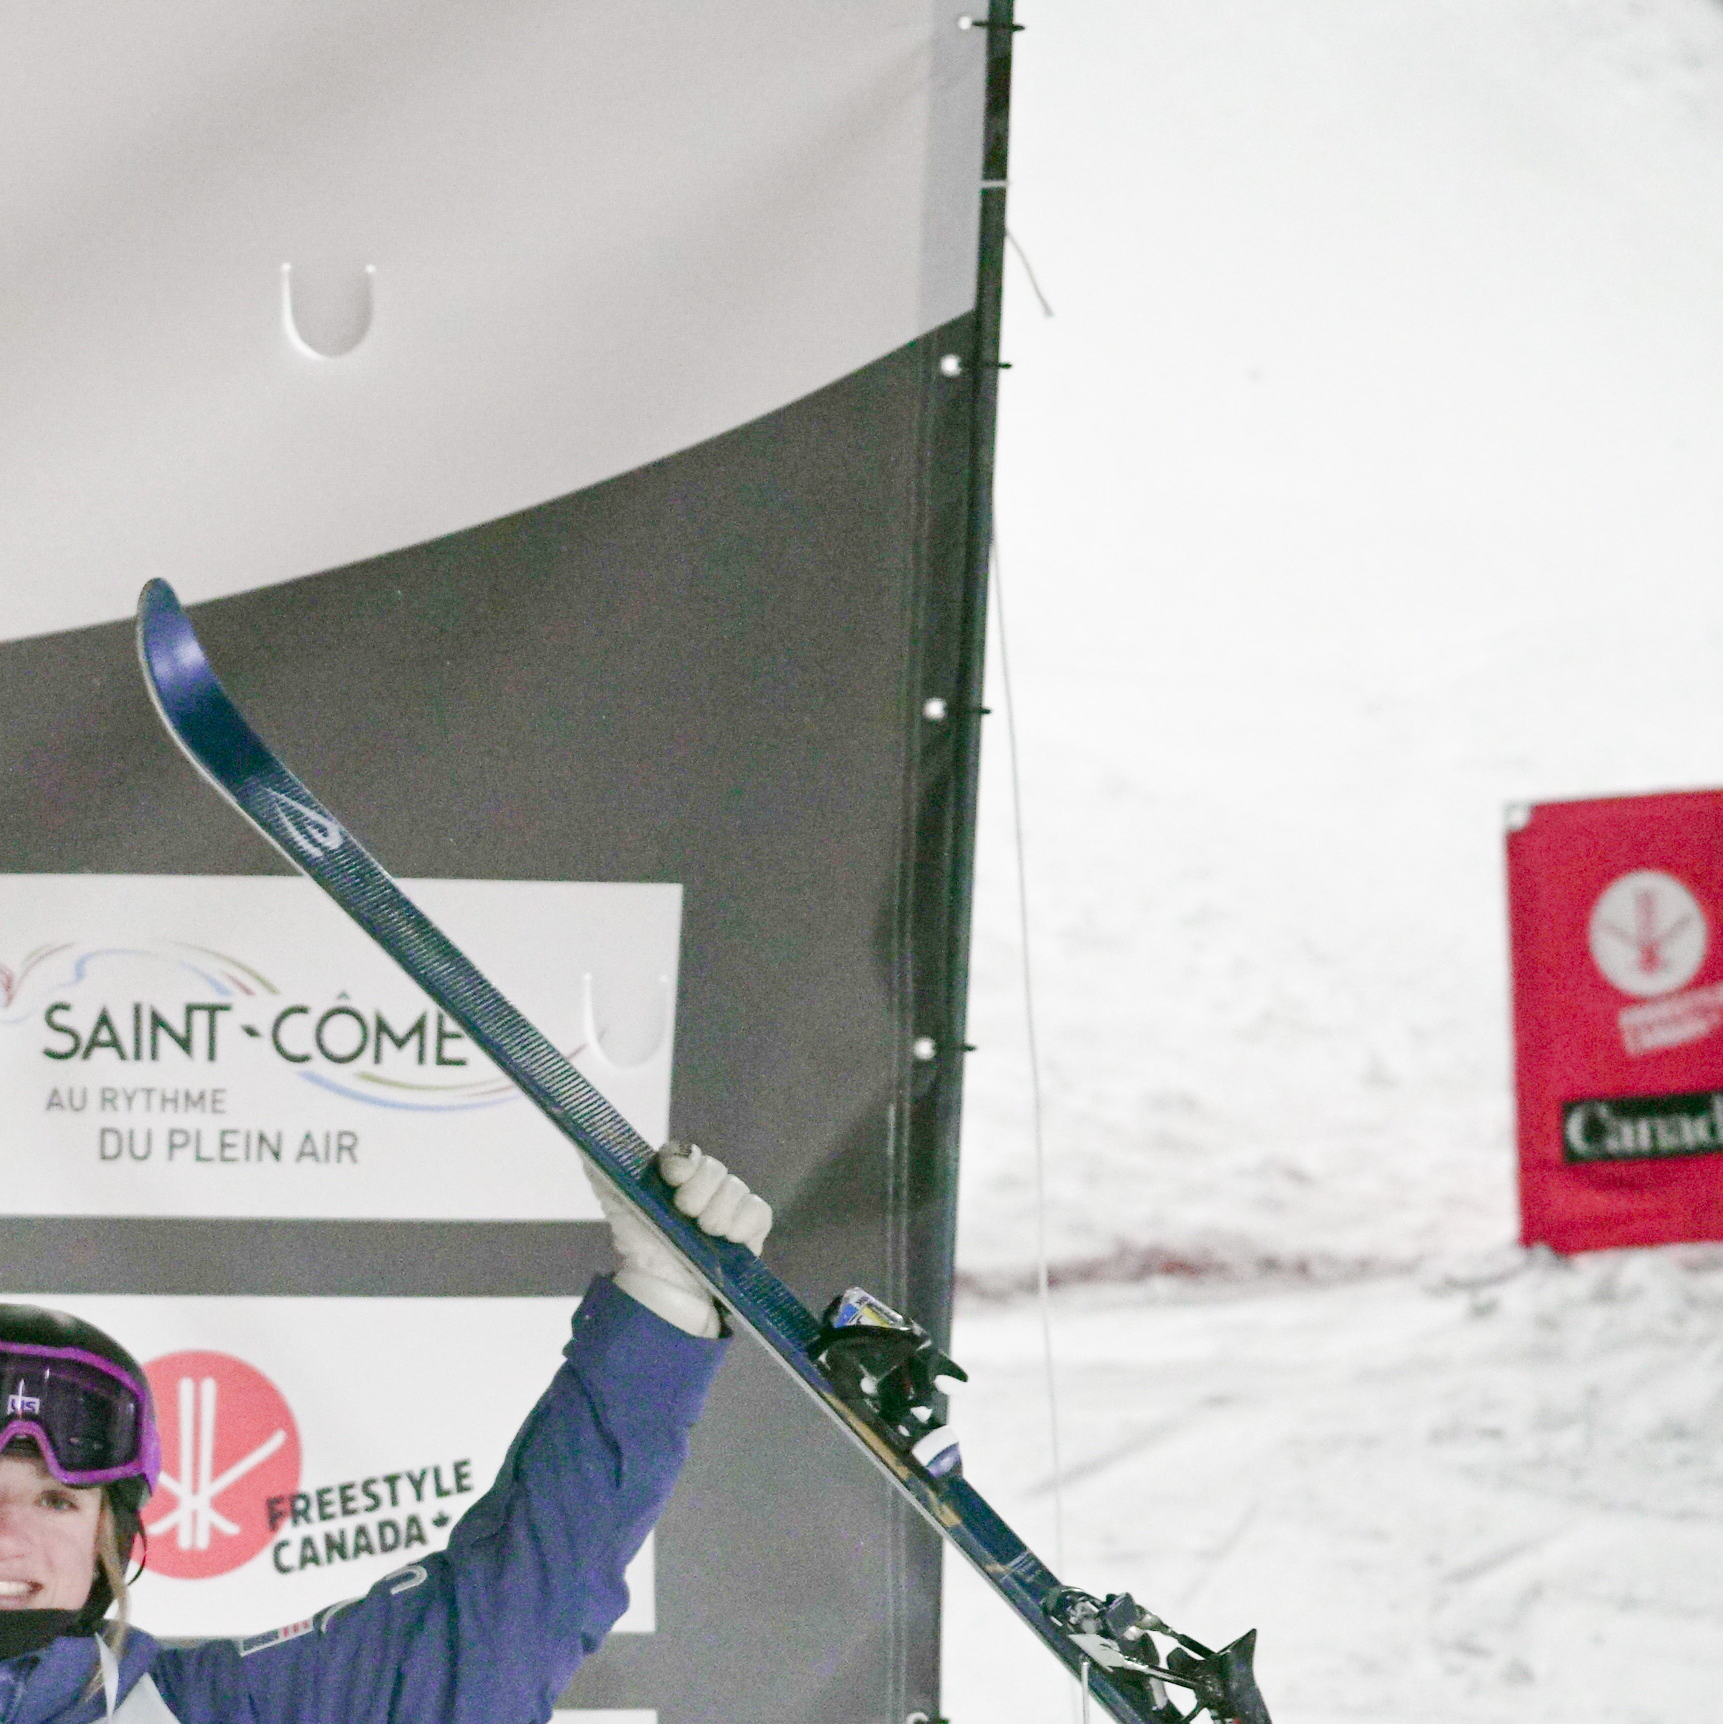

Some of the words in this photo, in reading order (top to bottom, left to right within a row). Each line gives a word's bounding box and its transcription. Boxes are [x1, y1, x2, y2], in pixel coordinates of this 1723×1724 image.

[45, 1089, 87, 1113] AU
[100, 1088, 227, 1114] RYTHME
[99, 1130, 156, 1162] DU
[168, 1130, 282, 1163] PLEIN
[295, 1131, 359, 1165] AIR
[266, 1458, 473, 1531] FREESTYLE
[272, 1514, 429, 1575] CANADA
